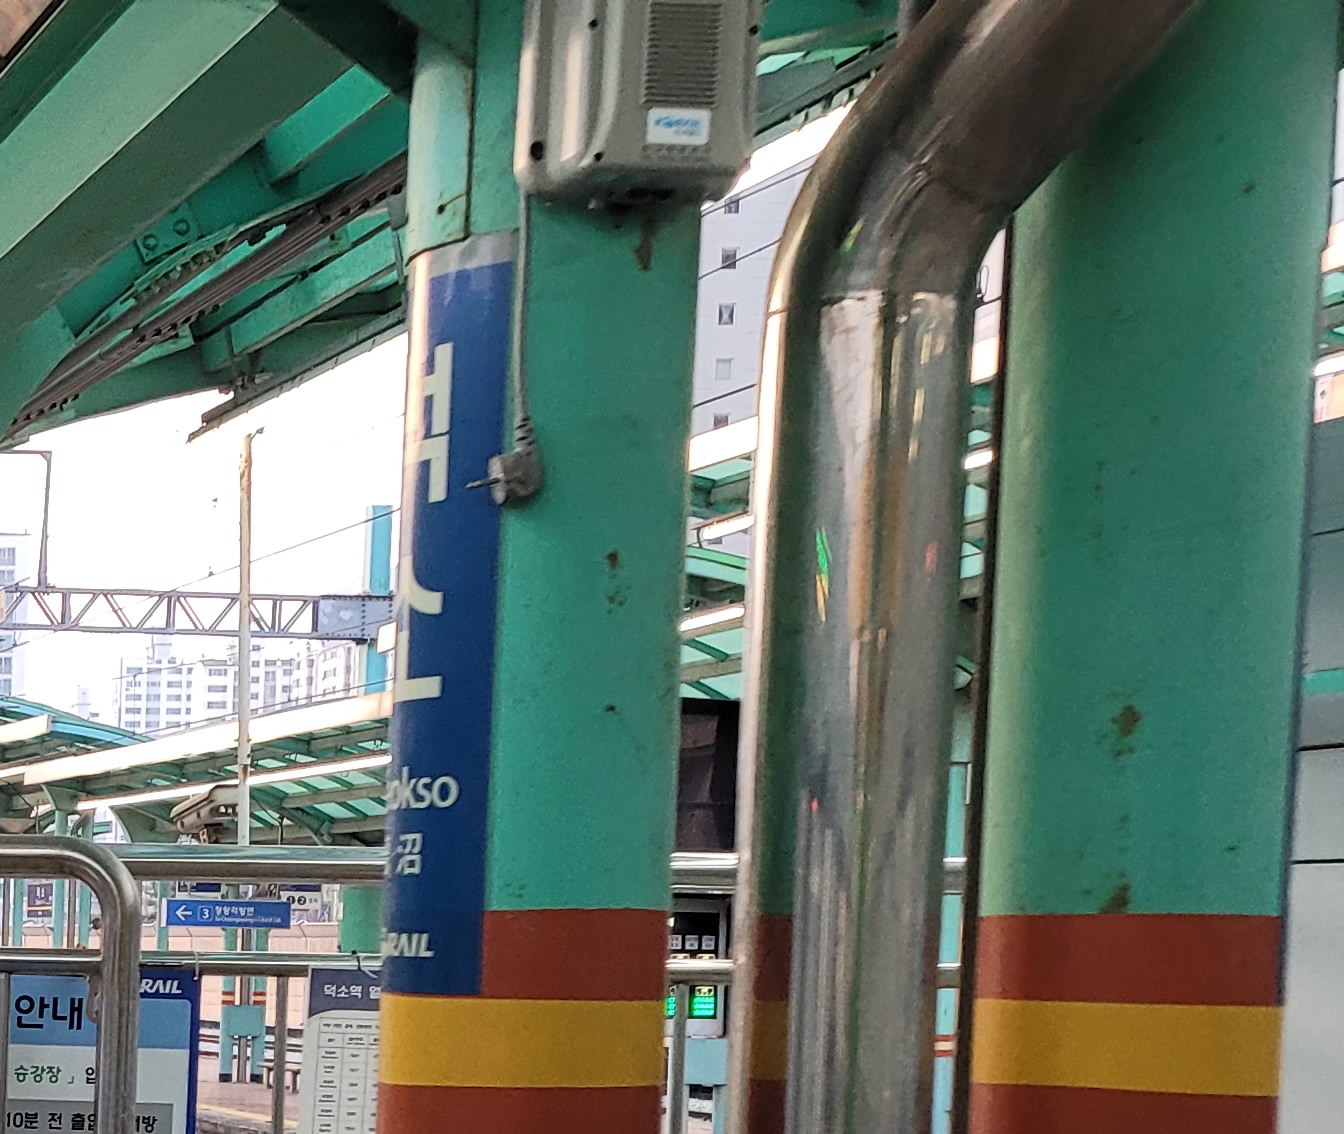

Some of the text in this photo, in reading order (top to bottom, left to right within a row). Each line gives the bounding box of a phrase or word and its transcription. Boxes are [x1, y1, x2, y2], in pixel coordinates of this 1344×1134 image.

[386, 766, 460, 809] okso
[201, 908, 210, 919] 3
[140, 979, 183, 994] RAIL
[324, 984, 363, 998] 덕소역
[15, 995, 84, 1030] 안내
[6, 1112, 39, 1130] 10분
[47, 1112, 63, 1130] 전
[70, 1112, 96, 1131] 출입
